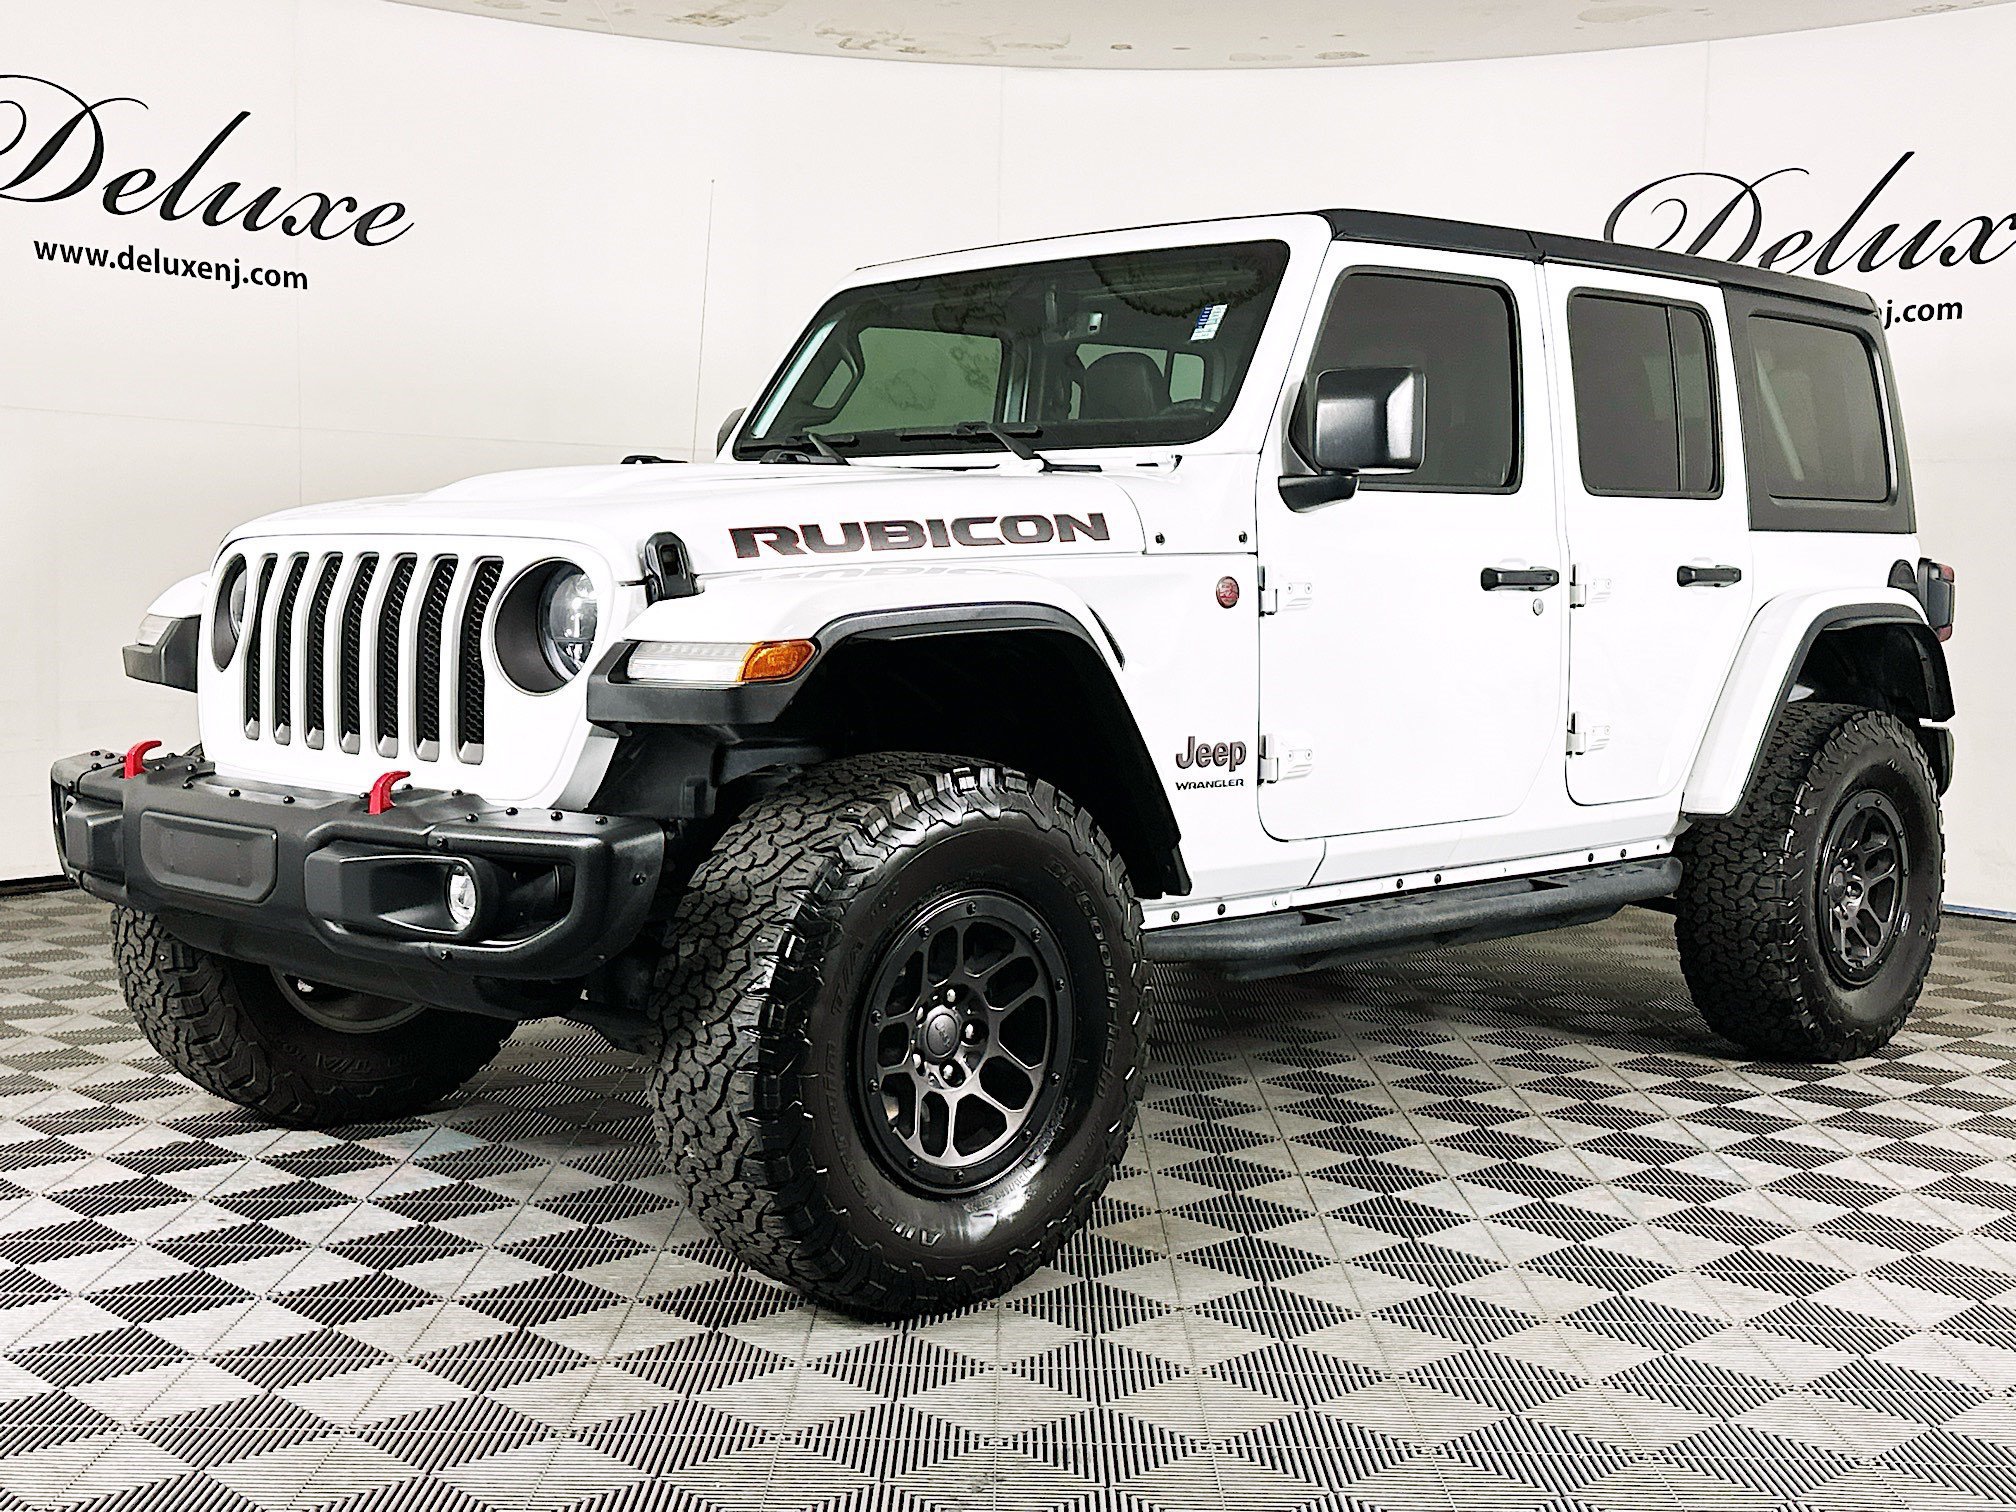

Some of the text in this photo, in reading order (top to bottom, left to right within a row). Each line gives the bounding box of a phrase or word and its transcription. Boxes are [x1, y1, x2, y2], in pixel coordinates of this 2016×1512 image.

[0, 74, 414, 247] Deluxe
[33, 239, 309, 290] www.deluxenj.com
[729, 512, 1111, 558] RUBICON
[1175, 735, 1247, 772] Jeep
[1175, 778, 1245, 791] WRANGLER
